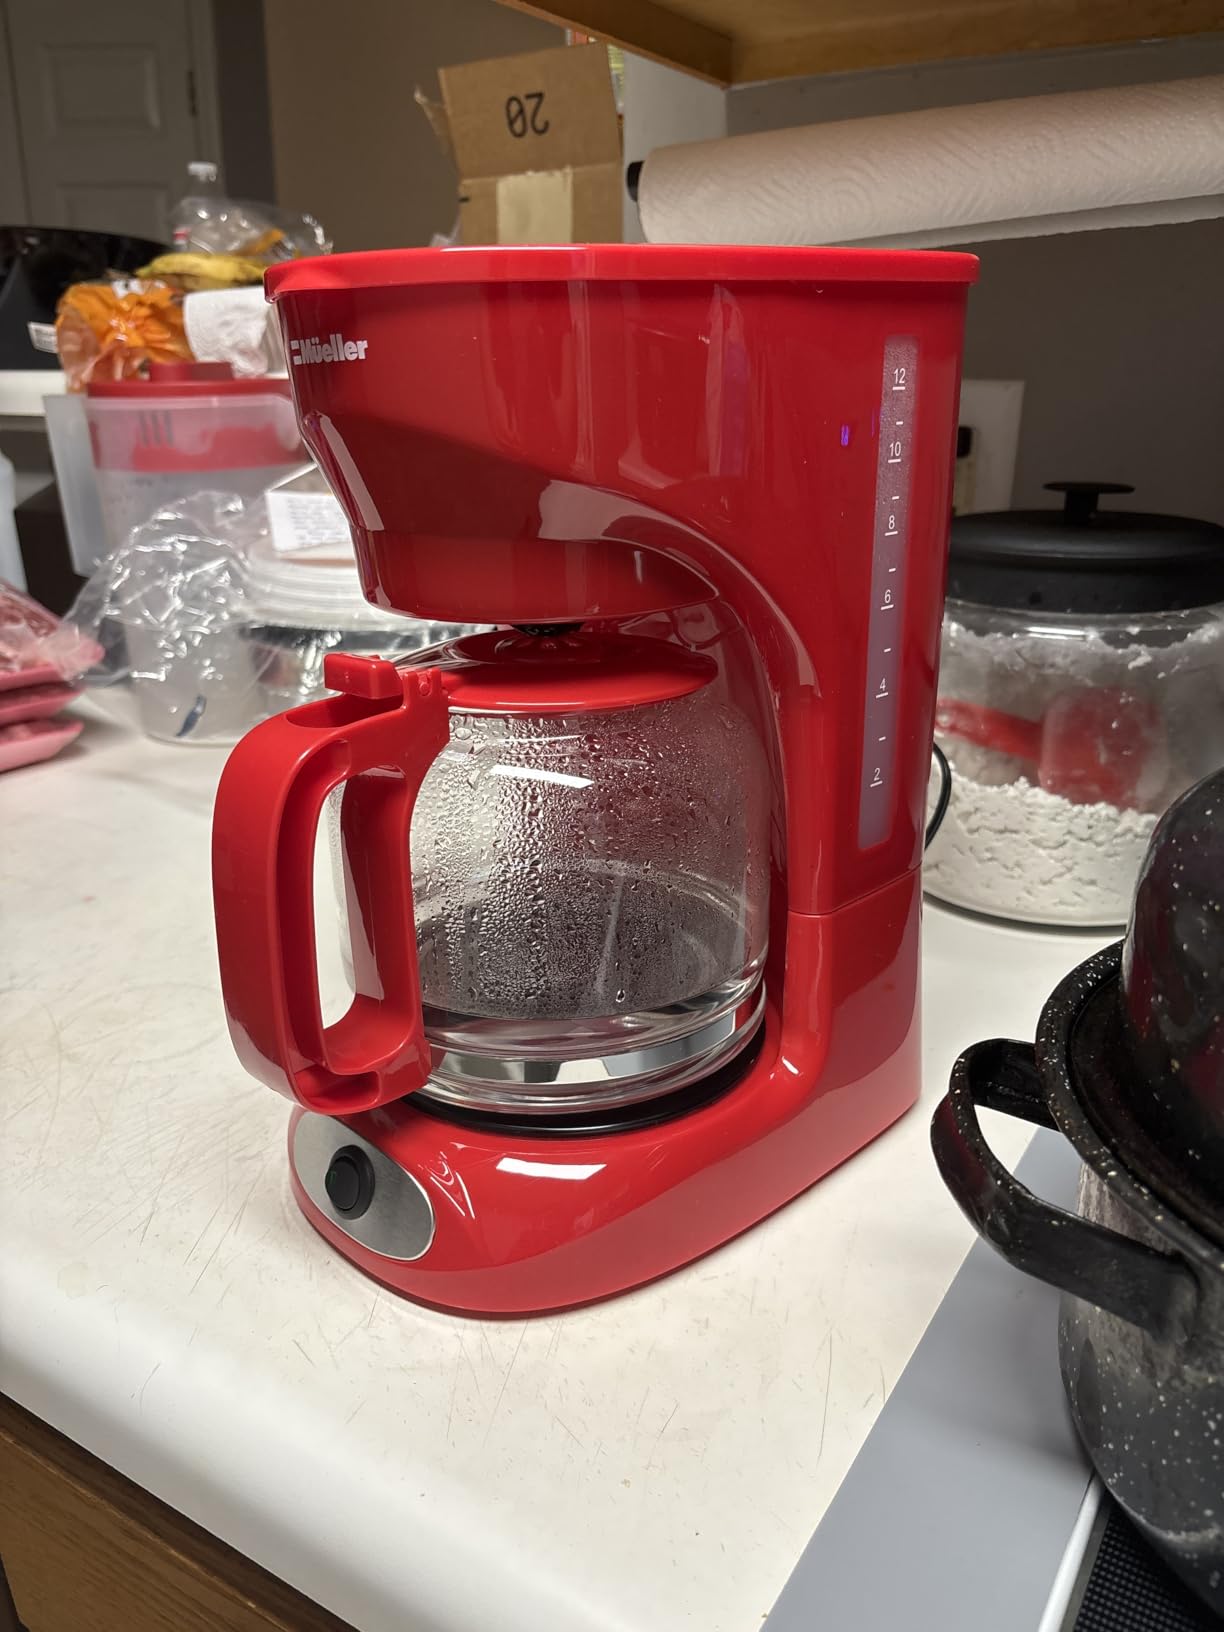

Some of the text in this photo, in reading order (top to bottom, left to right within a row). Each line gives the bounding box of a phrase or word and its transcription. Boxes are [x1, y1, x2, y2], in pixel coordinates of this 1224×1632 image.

[893, 367, 906, 384] 12
[889, 441, 901, 458] 10
[888, 515, 895, 530] 8
[884, 589, 891, 604] 6
[879, 678, 886, 691] 4
[873, 768, 880, 781] 2
